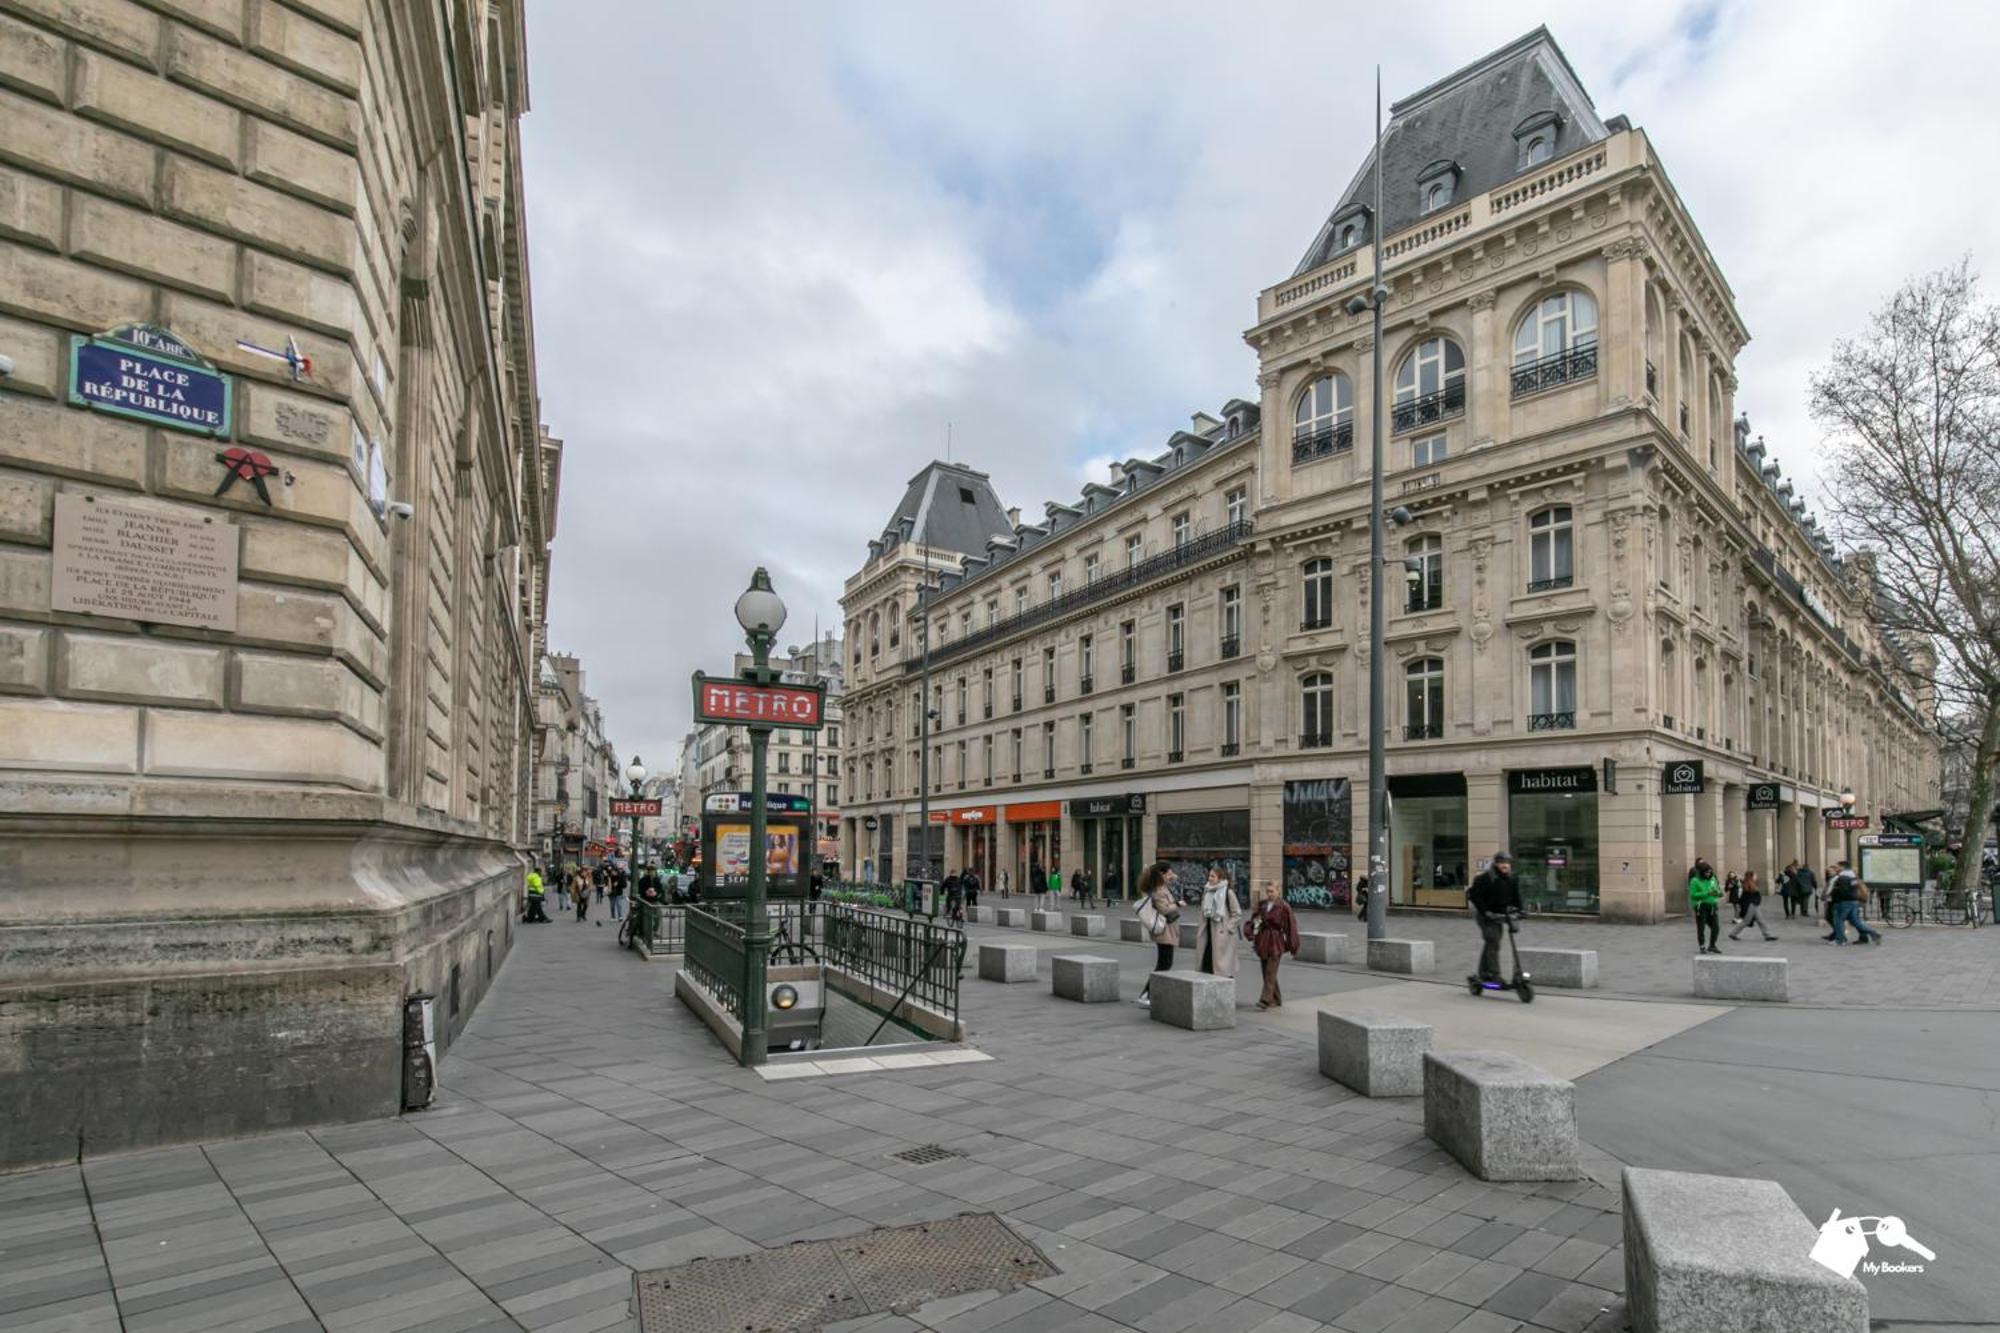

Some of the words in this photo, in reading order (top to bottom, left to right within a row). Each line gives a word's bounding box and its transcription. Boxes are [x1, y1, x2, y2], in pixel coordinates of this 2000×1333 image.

[120, 358, 189, 386] PLACE
[122, 375, 149, 393] DE
[157, 384, 186, 401] LA
[84, 381, 219, 424] RÉPUBLIQUE
[124, 519, 173, 536] JEANNE
[120, 539, 175, 555] DAUSSET
[76, 574, 111, 586] PLACE
[169, 608, 219, 621] CAPITALE
[710, 687, 812, 718] METRO
[1521, 772, 1579, 788] habitat
[1668, 784, 1700, 793] habitat
[614, 801, 658, 814] METRO
[1830, 819, 1865, 828] METRO
